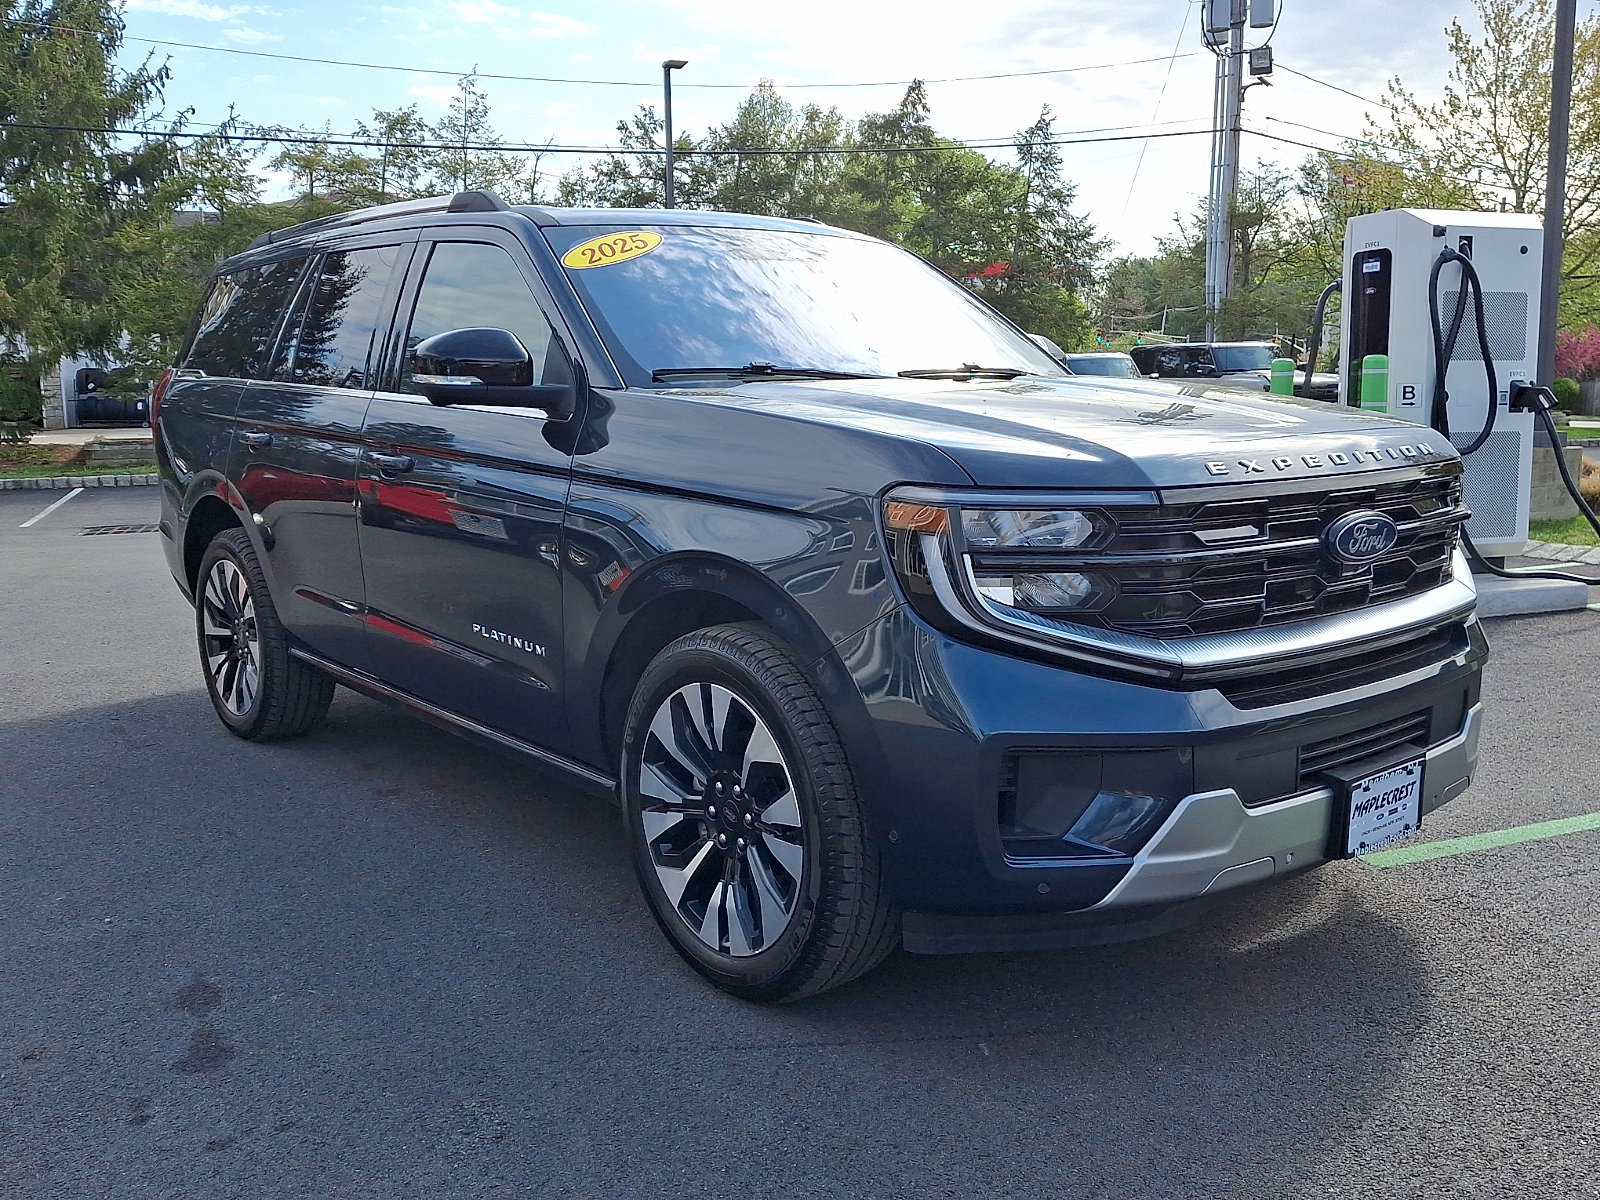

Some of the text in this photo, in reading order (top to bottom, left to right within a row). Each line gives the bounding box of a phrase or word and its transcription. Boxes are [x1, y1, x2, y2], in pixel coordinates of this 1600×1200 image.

[581, 234, 648, 264] 2025
[1402, 385, 1416, 400] B
[1205, 442, 1436, 476] EXPEDITION
[1350, 522, 1387, 554] Ford
[472, 623, 547, 657] PLATINUM
[1352, 780, 1417, 820] MAPLECREST
